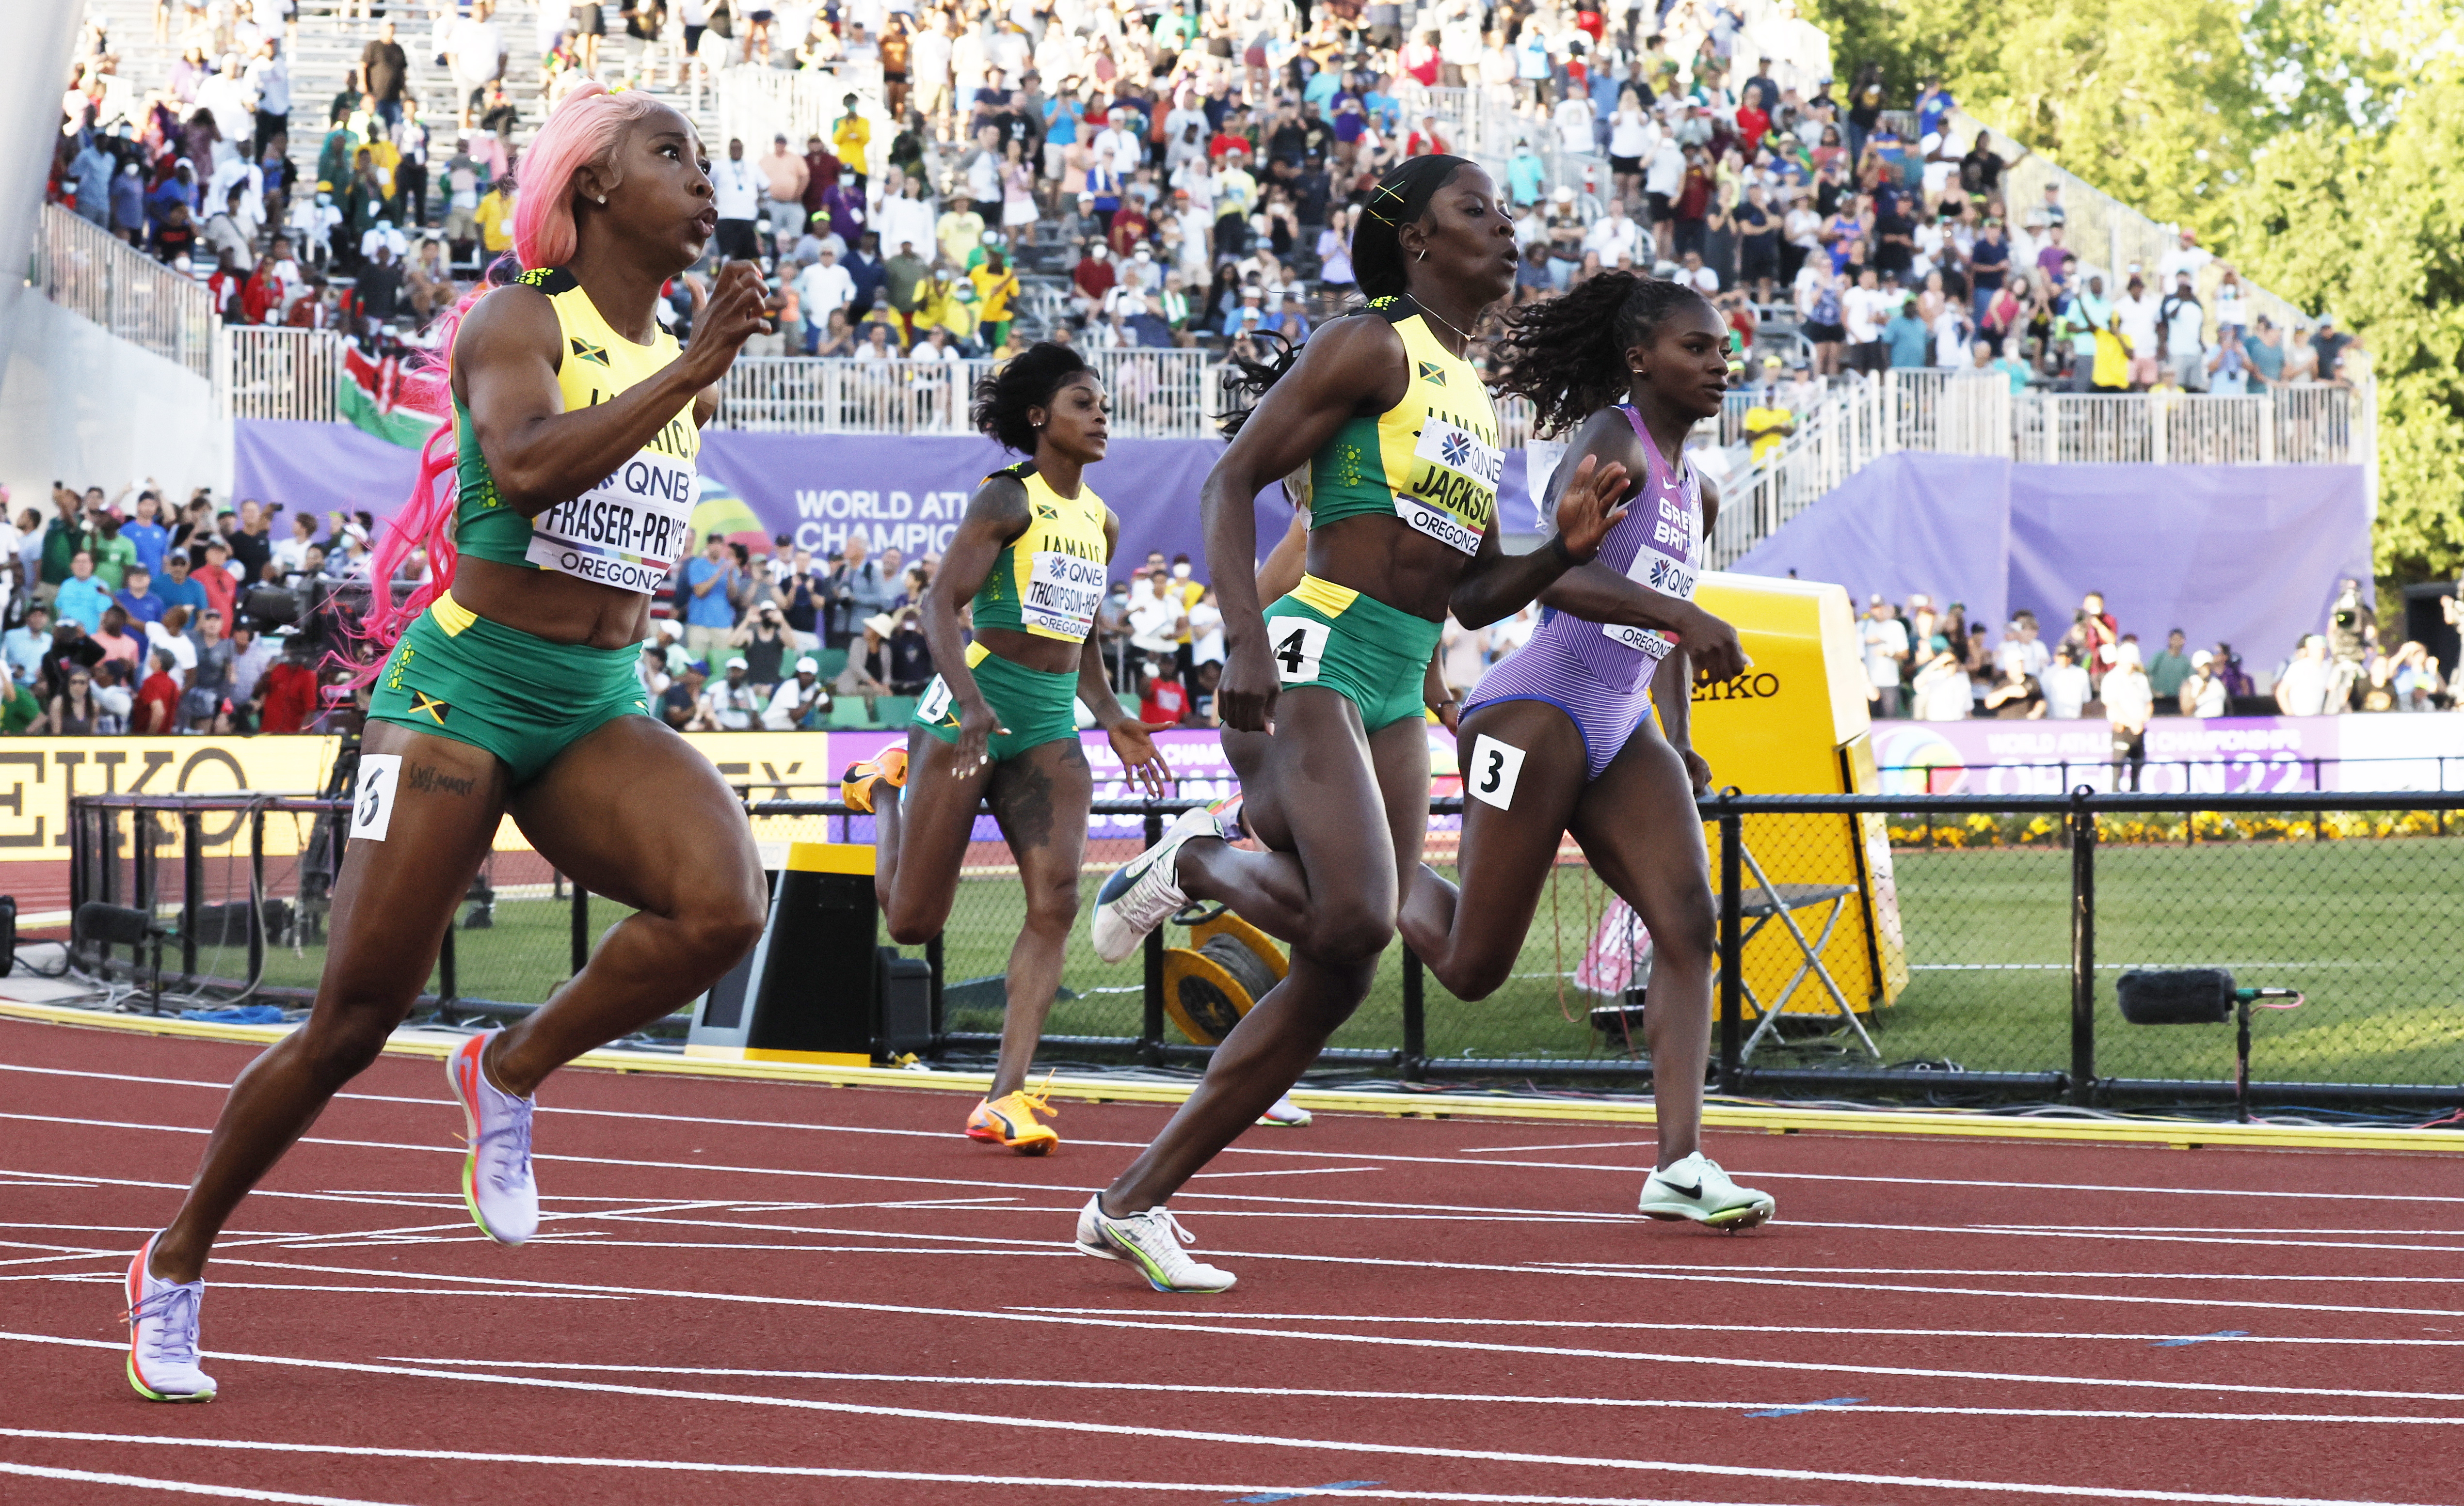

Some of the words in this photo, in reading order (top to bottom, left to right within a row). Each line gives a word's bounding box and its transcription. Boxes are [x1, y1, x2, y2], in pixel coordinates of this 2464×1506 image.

[625, 461, 689, 503] QNB
[1472, 447, 1503, 484] QNB
[796, 490, 913, 519] WORLD
[1413, 465, 1493, 525] JACKSO
[545, 498, 686, 559] FRASER-PRYCE
[1070, 563, 1103, 587] QNB
[1668, 569, 1693, 598] QNB
[1273, 628, 1307, 673] 4
[927, 682, 944, 716] 2
[1986, 732, 2055, 755] WORLD
[1481, 750, 1504, 793] 3
[359, 767, 384, 826] 6
